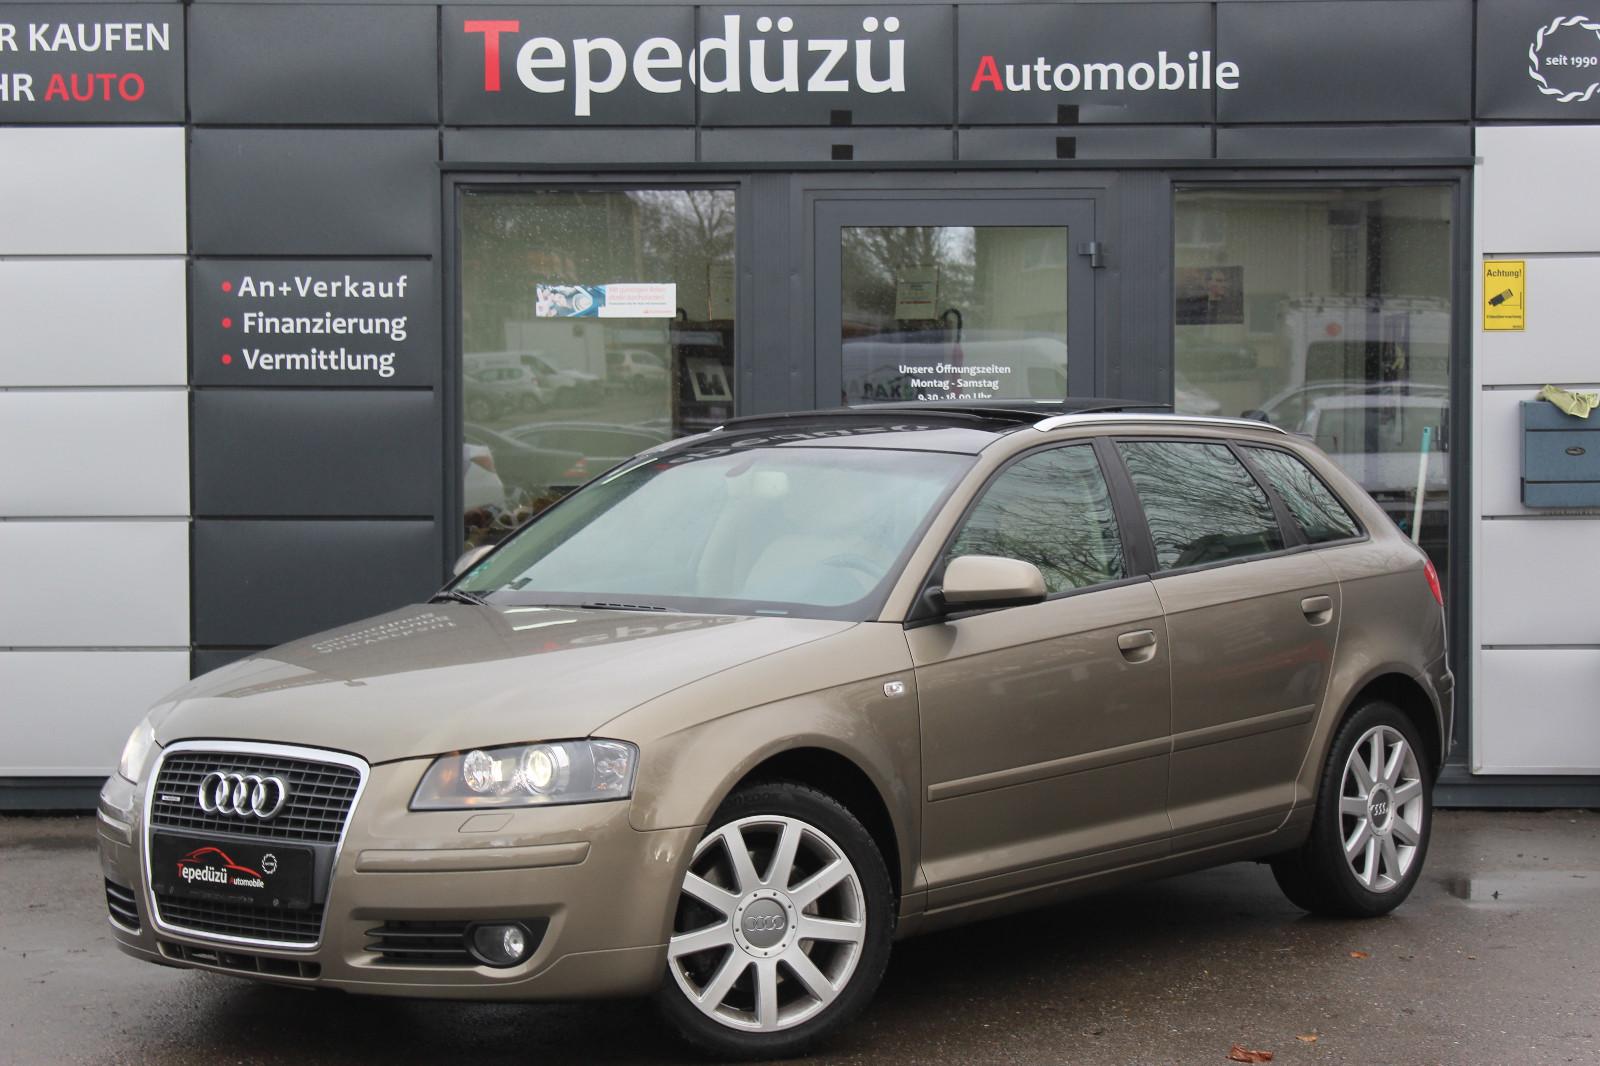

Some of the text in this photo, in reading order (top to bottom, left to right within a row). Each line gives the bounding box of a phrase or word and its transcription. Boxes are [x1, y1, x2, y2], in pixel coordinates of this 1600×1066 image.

[28, 23, 170, 52] KAUFEN
[463, 14, 906, 117] Tepedüzü
[970, 50, 1241, 93] Automobile
[1545, 54, 1598, 68] seit 1990
[44, 72, 146, 102] AUTO
[237, 275, 408, 298] An+Verkauf
[1486, 269, 1522, 278] Achtung!
[243, 313, 408, 341] Finanzierung
[243, 349, 396, 377] Vermittlung
[898, 363, 1011, 376] Unsere Öffnungszeiten
[911, 379, 949, 390] Montag
[957, 379, 999, 390] Samstag
[177, 863, 265, 889] Tepedüzü Automobile
